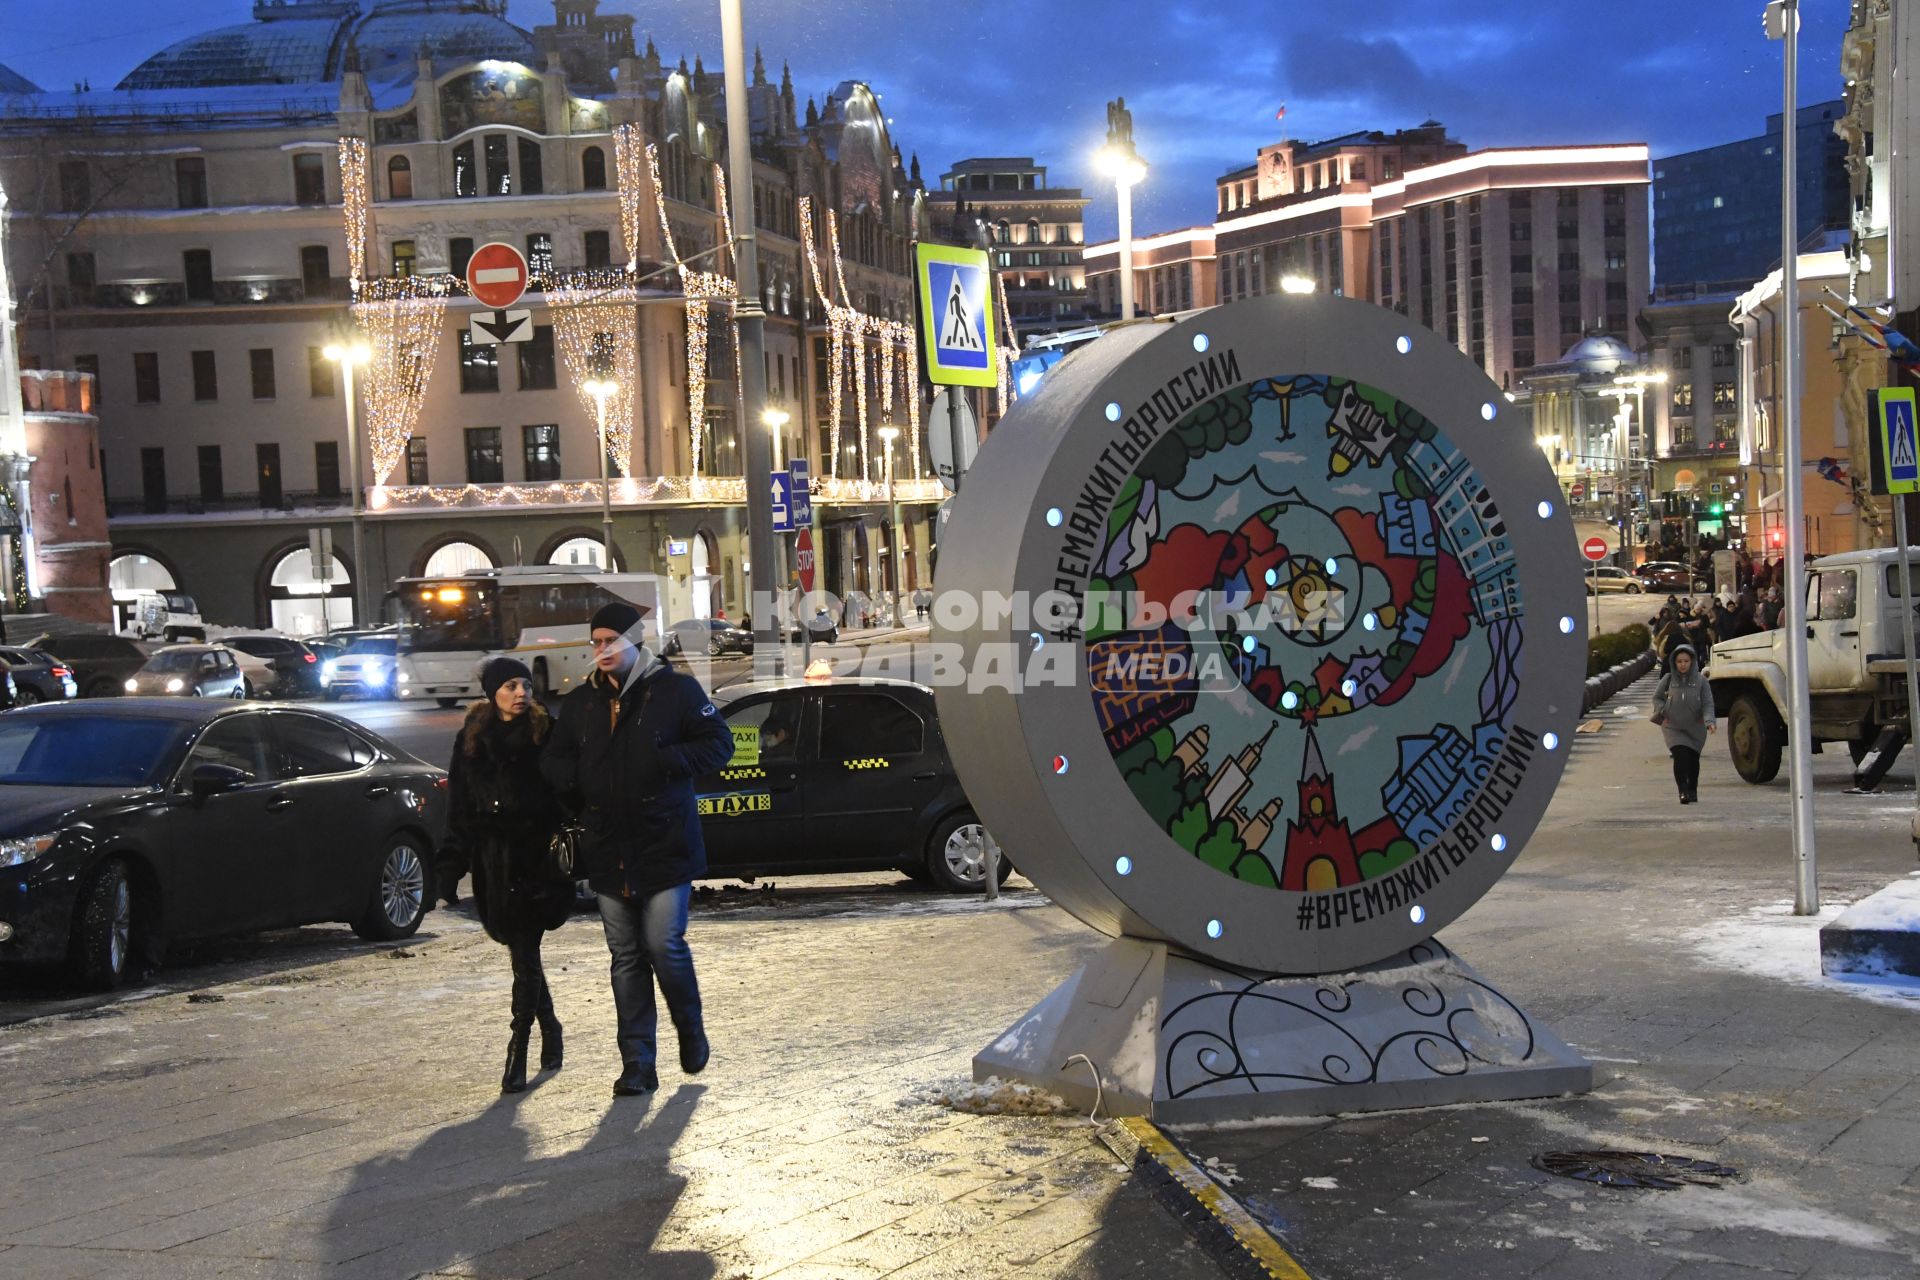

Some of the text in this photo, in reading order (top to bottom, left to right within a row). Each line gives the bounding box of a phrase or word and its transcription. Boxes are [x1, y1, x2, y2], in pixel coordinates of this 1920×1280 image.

[1050, 348, 1242, 642] #ВРЕМЯЖИТЬВРОССИИ
[798, 550, 814, 571] STOP
[731, 732, 756, 743] TAXI
[708, 795, 760, 813] TAXI
[1296, 724, 1539, 931] #ВРЕМЯЖИТЬВРОССИИ
